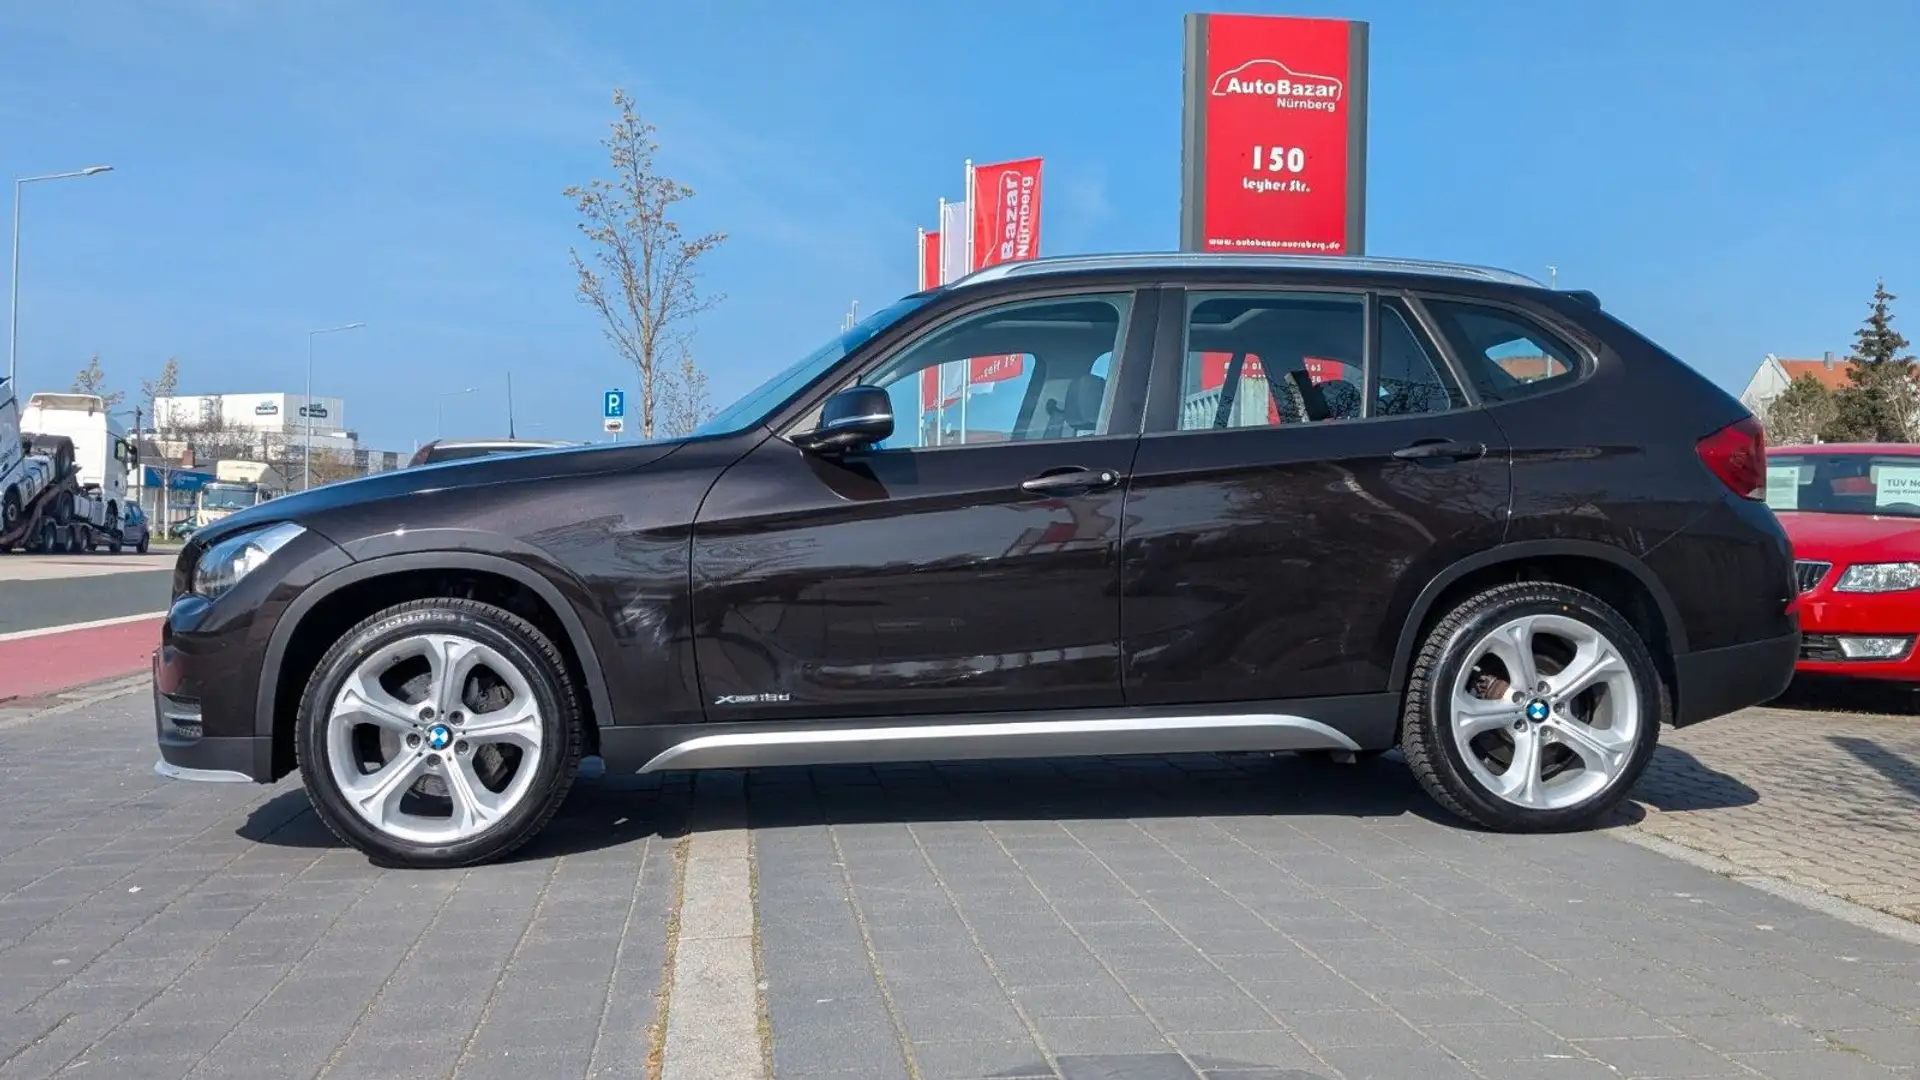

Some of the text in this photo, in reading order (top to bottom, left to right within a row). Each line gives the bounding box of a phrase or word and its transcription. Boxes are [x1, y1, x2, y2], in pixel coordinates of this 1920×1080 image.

[1226, 77, 1337, 97] AutoBazar
[1276, 97, 1335, 112] Nürnberg
[1253, 146, 1304, 172] 150
[1243, 177, 1311, 192] Leyher Str.
[1016, 176, 1034, 257] Nürnberg
[608, 394, 620, 414] P
[1886, 478, 1907, 487] TÜV
